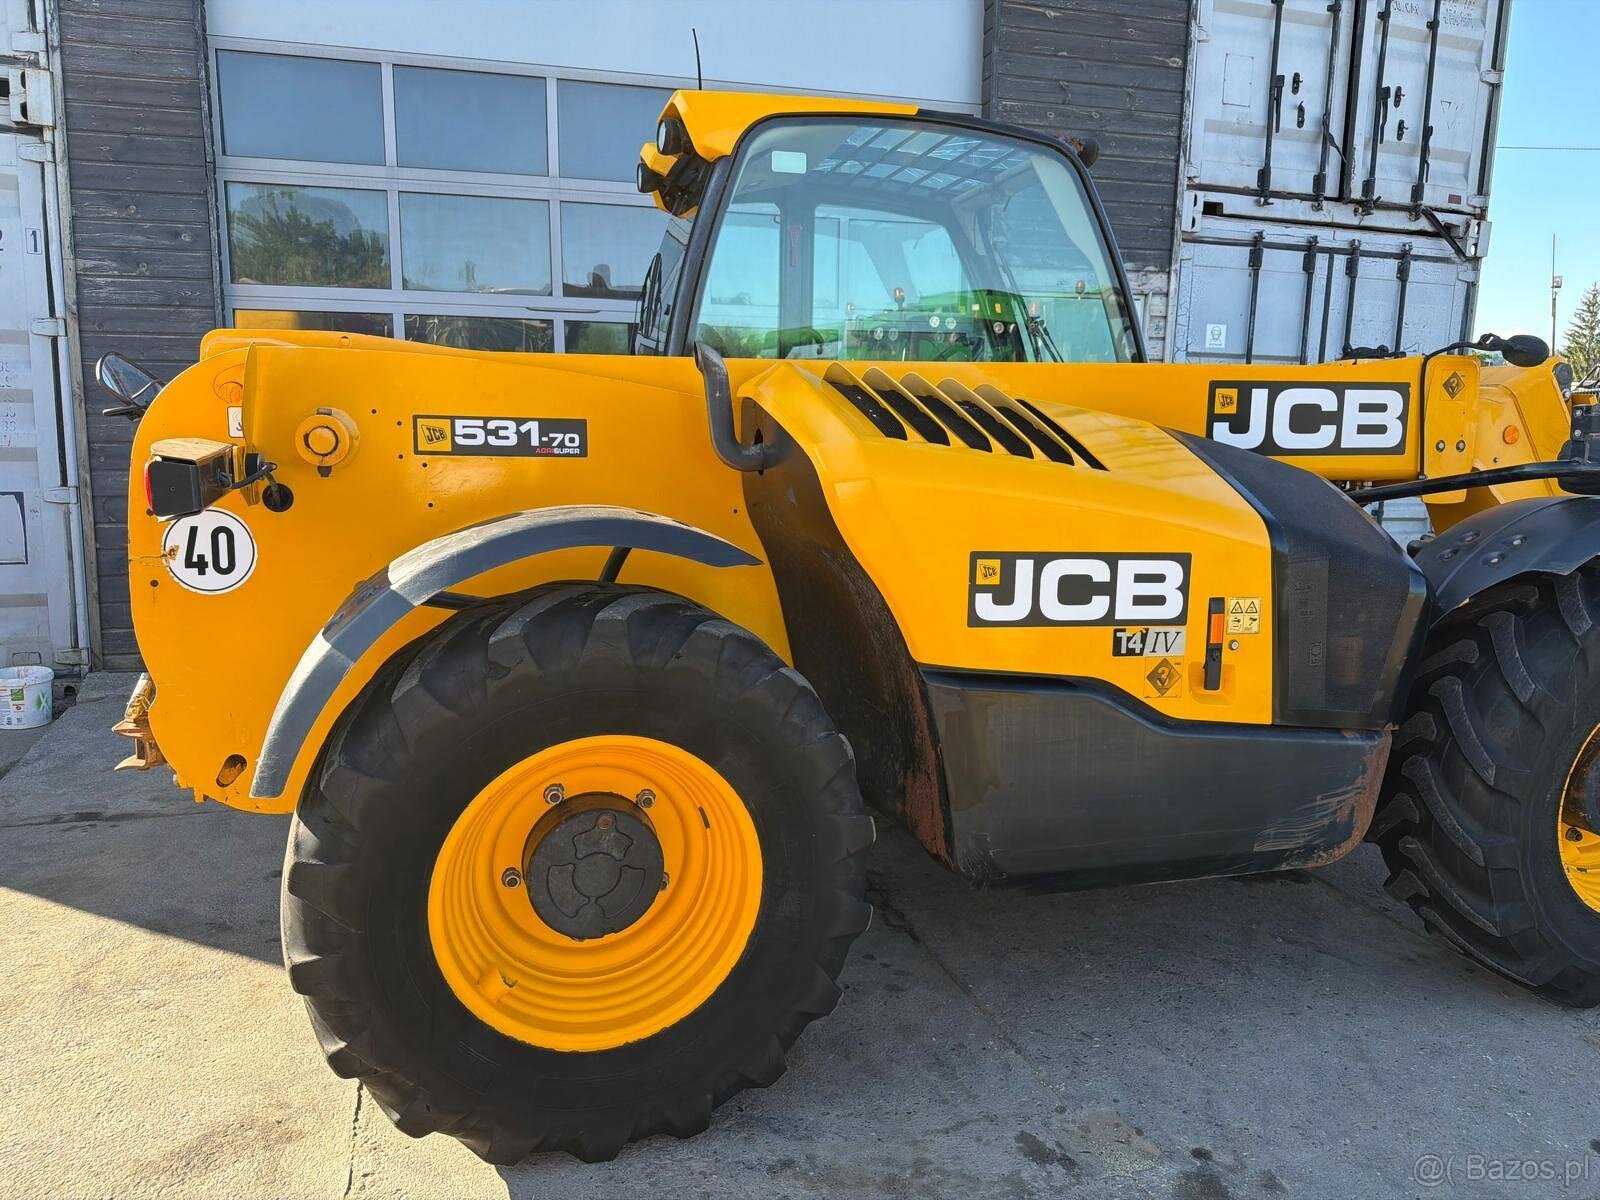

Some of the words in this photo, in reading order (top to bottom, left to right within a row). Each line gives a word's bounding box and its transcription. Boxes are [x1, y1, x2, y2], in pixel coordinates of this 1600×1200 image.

[31, 230, 38, 252] 1
[1220, 393, 1234, 406] JCB
[1213, 388, 1403, 449] JCB
[426, 427, 447, 442] JCB
[454, 419, 580, 447] 531-70
[184, 525, 236, 575] 40
[982, 565, 997, 578] JCB
[975, 558, 1183, 621] JCB
